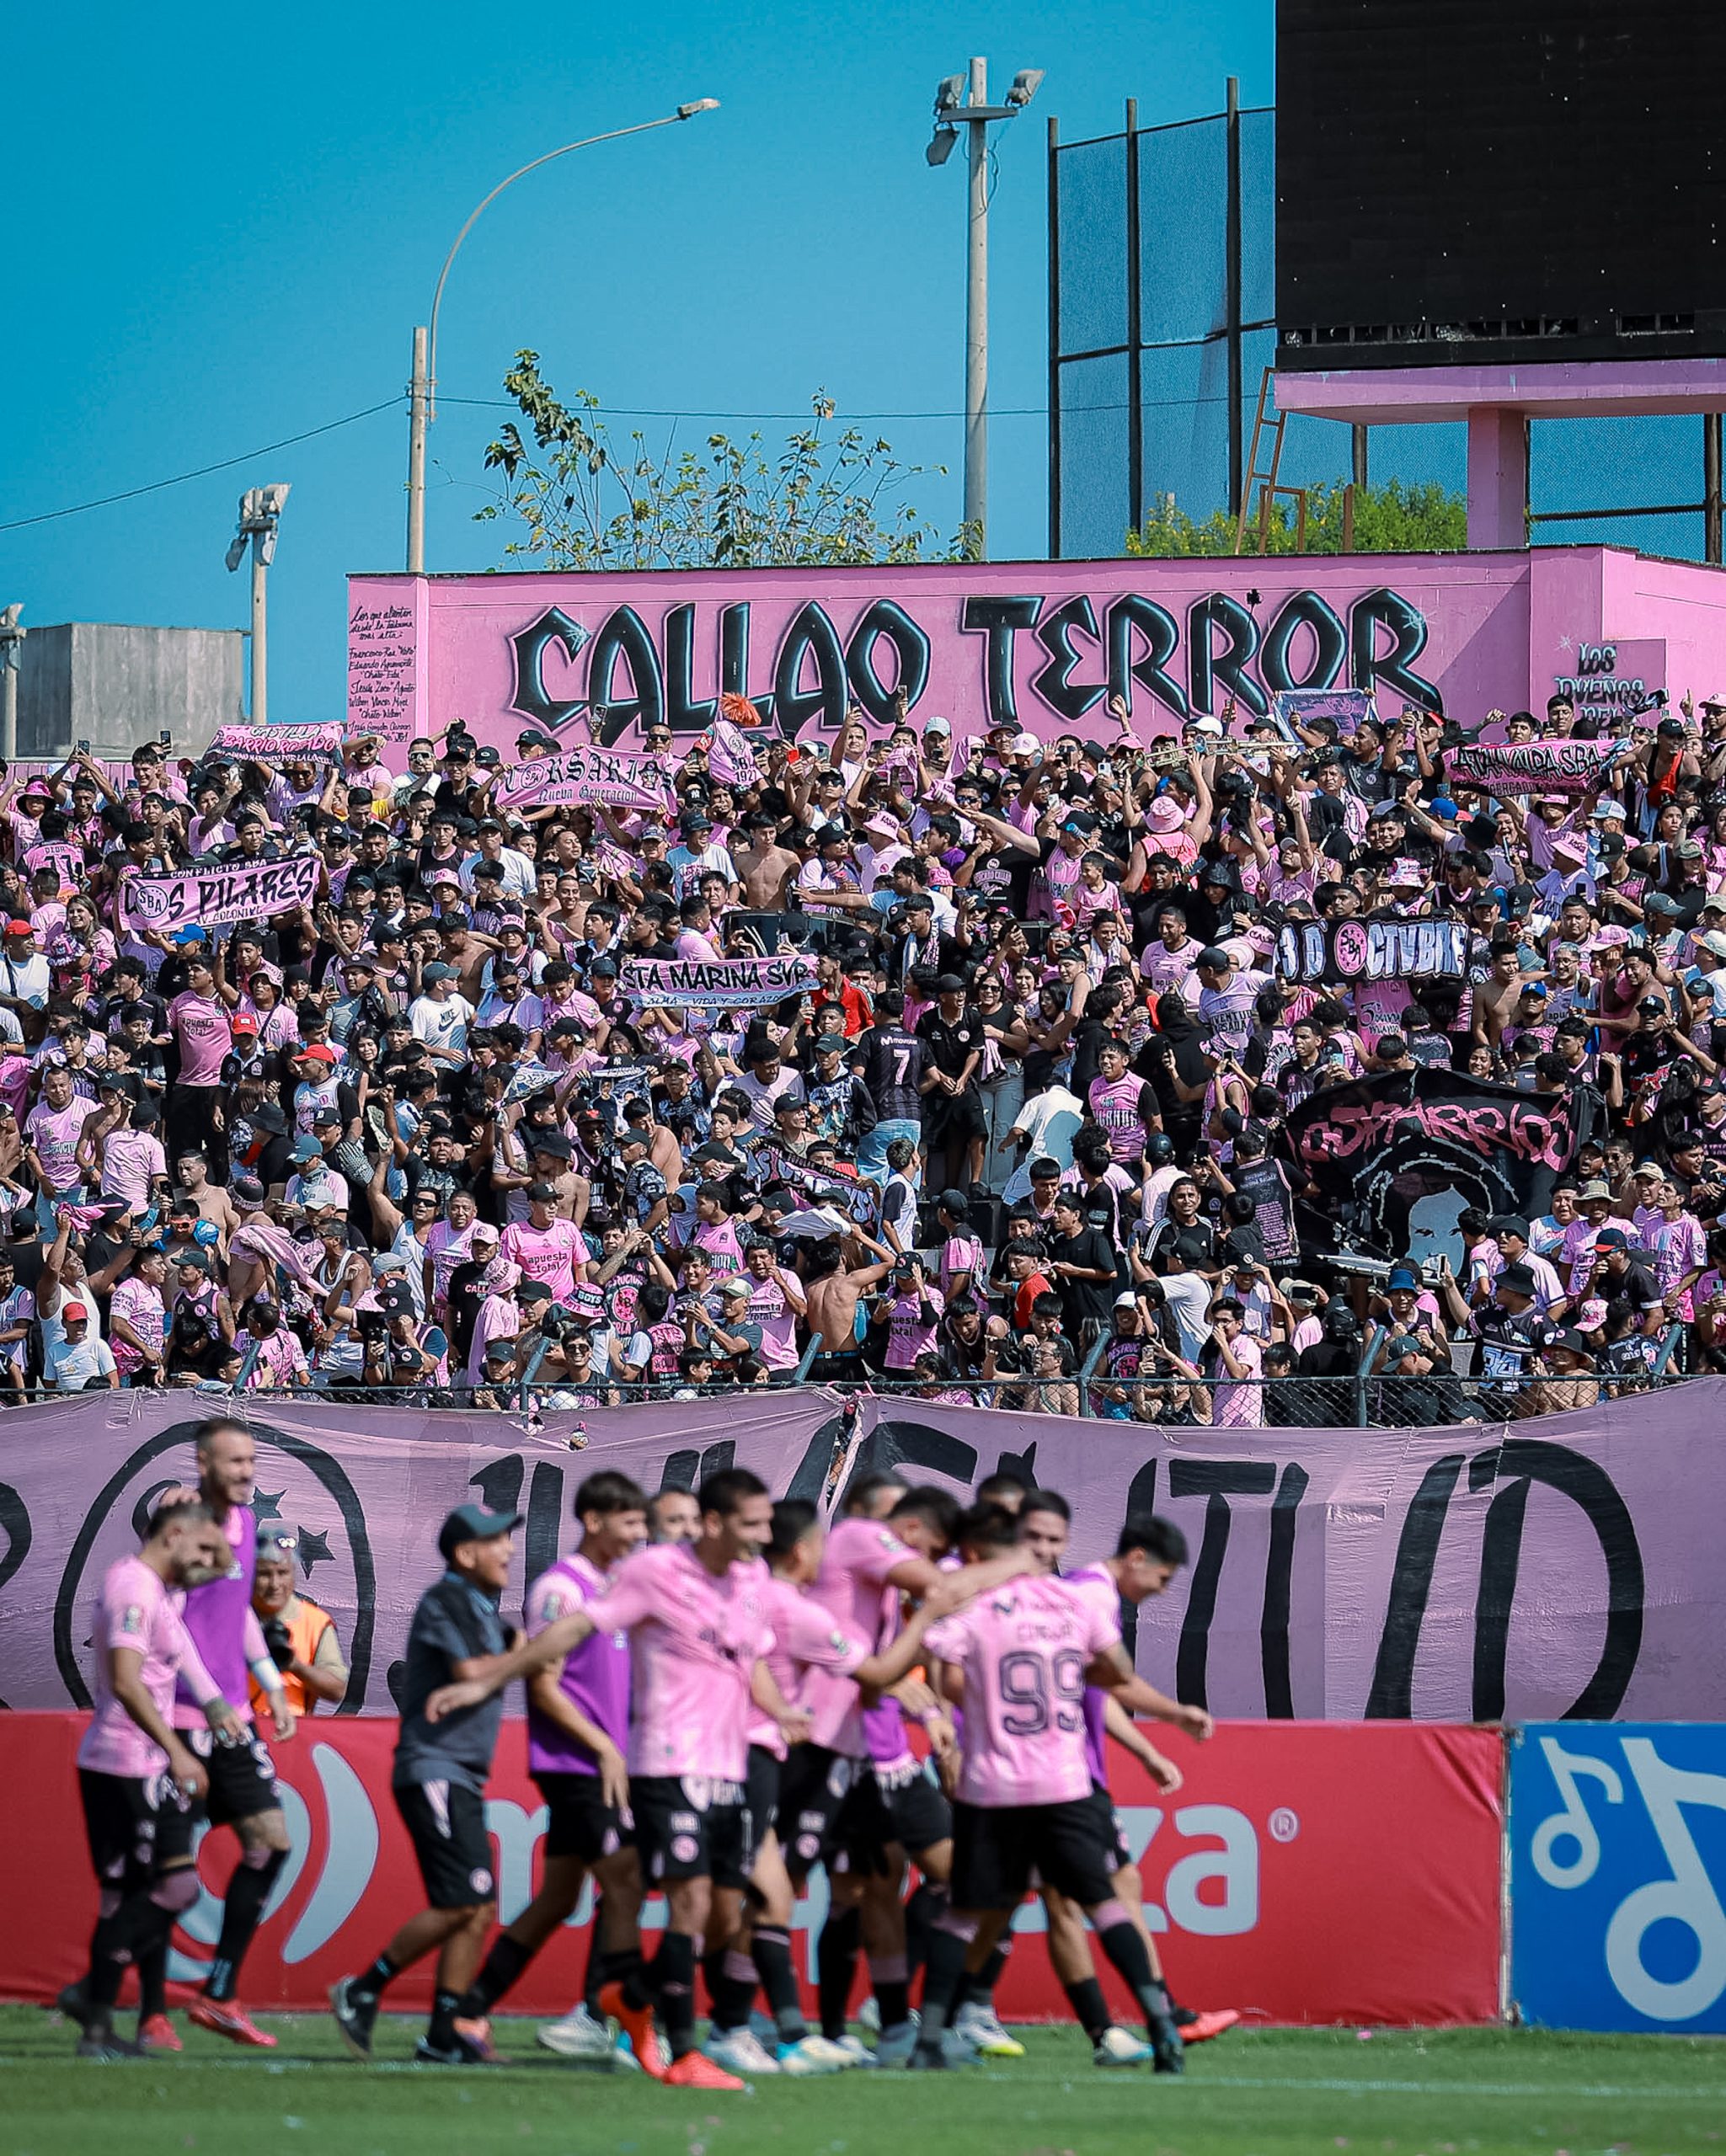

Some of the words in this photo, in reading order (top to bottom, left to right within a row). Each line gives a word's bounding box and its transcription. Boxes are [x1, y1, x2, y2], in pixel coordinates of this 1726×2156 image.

[510, 598, 931, 744] CALLAO
[962, 589, 1444, 726] TERROR
[1578, 642, 1617, 675] LOS
[222, 735, 278, 754] BARRIO
[277, 736, 335, 755] ROSADO
[250, 725, 322, 739] CASTILLA
[1560, 744, 1602, 774] SBA
[170, 863, 239, 878] CONFLICTO
[243, 859, 267, 870] SBA
[197, 861, 314, 915] PILARES
[623, 962, 665, 990] STA
[669, 961, 765, 991] MARINA
[440, 1008, 454, 1022] NIKE
[894, 1049, 910, 1085] 7
[527, 1251, 569, 1264] apuesta
[537, 1262, 561, 1273] total
[465, 1284, 489, 1294] CALL
[1000, 1648, 1087, 1737] 99
